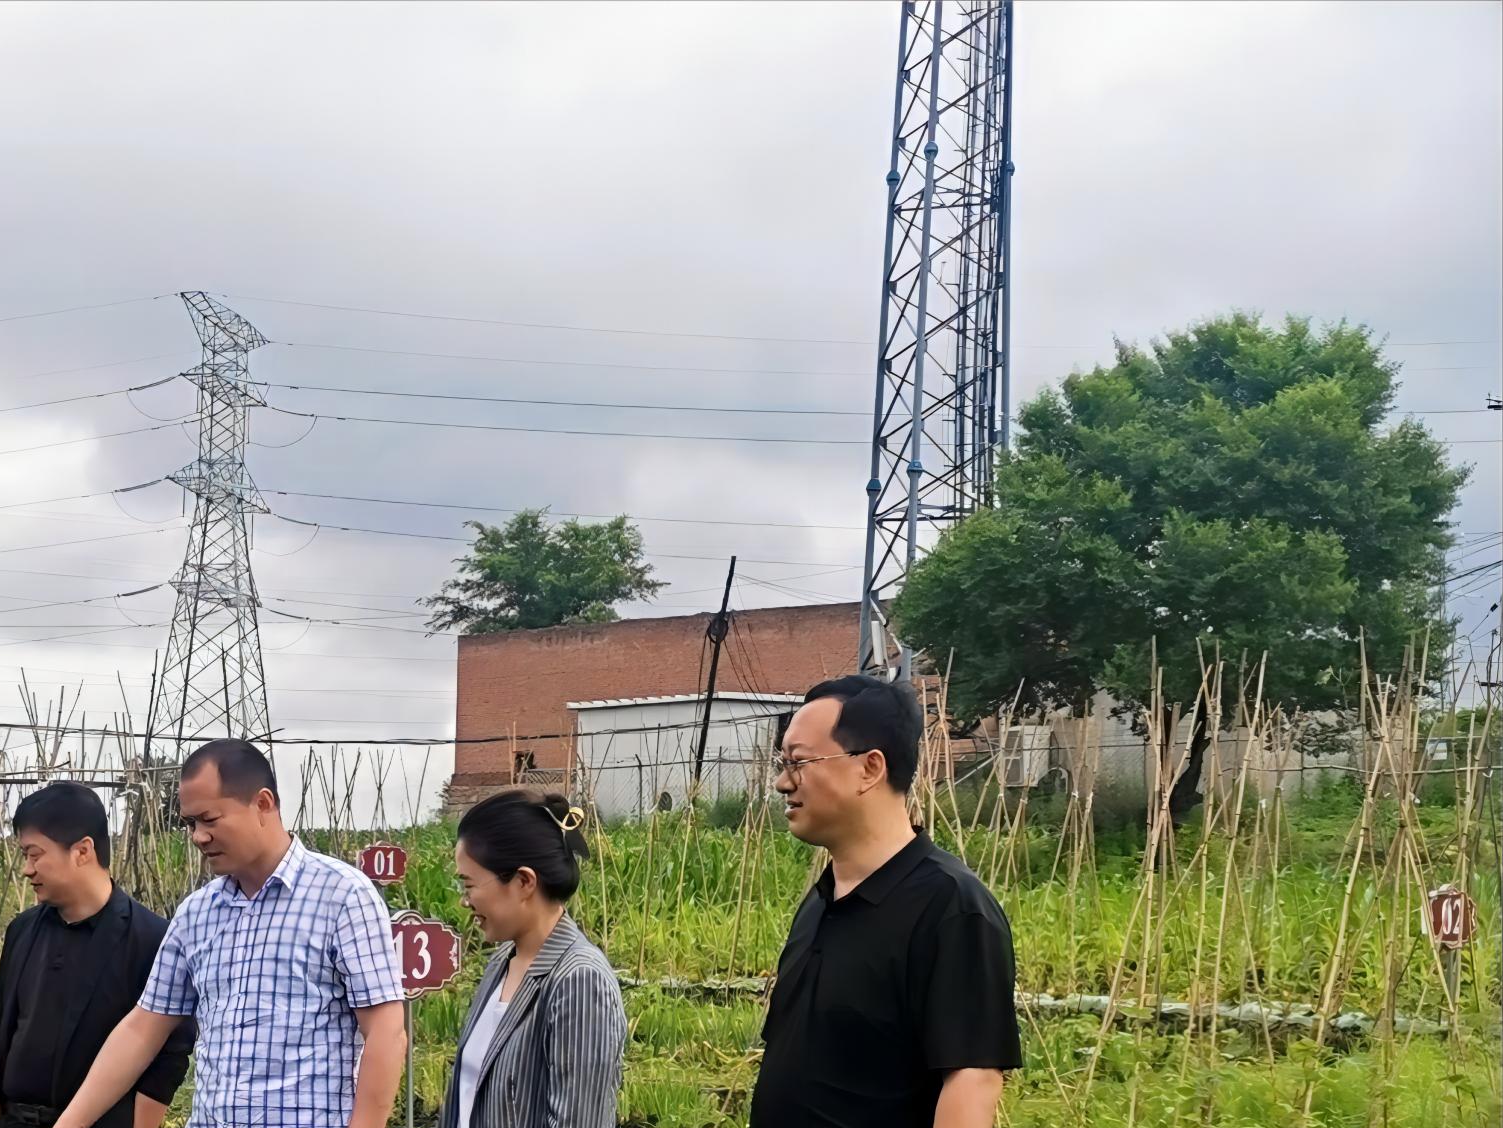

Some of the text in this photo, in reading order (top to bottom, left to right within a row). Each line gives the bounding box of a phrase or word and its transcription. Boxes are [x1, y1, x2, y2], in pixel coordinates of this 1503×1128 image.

[374, 850, 396, 876] 01
[1441, 897, 1463, 935] 02
[393, 930, 432, 980] 13
